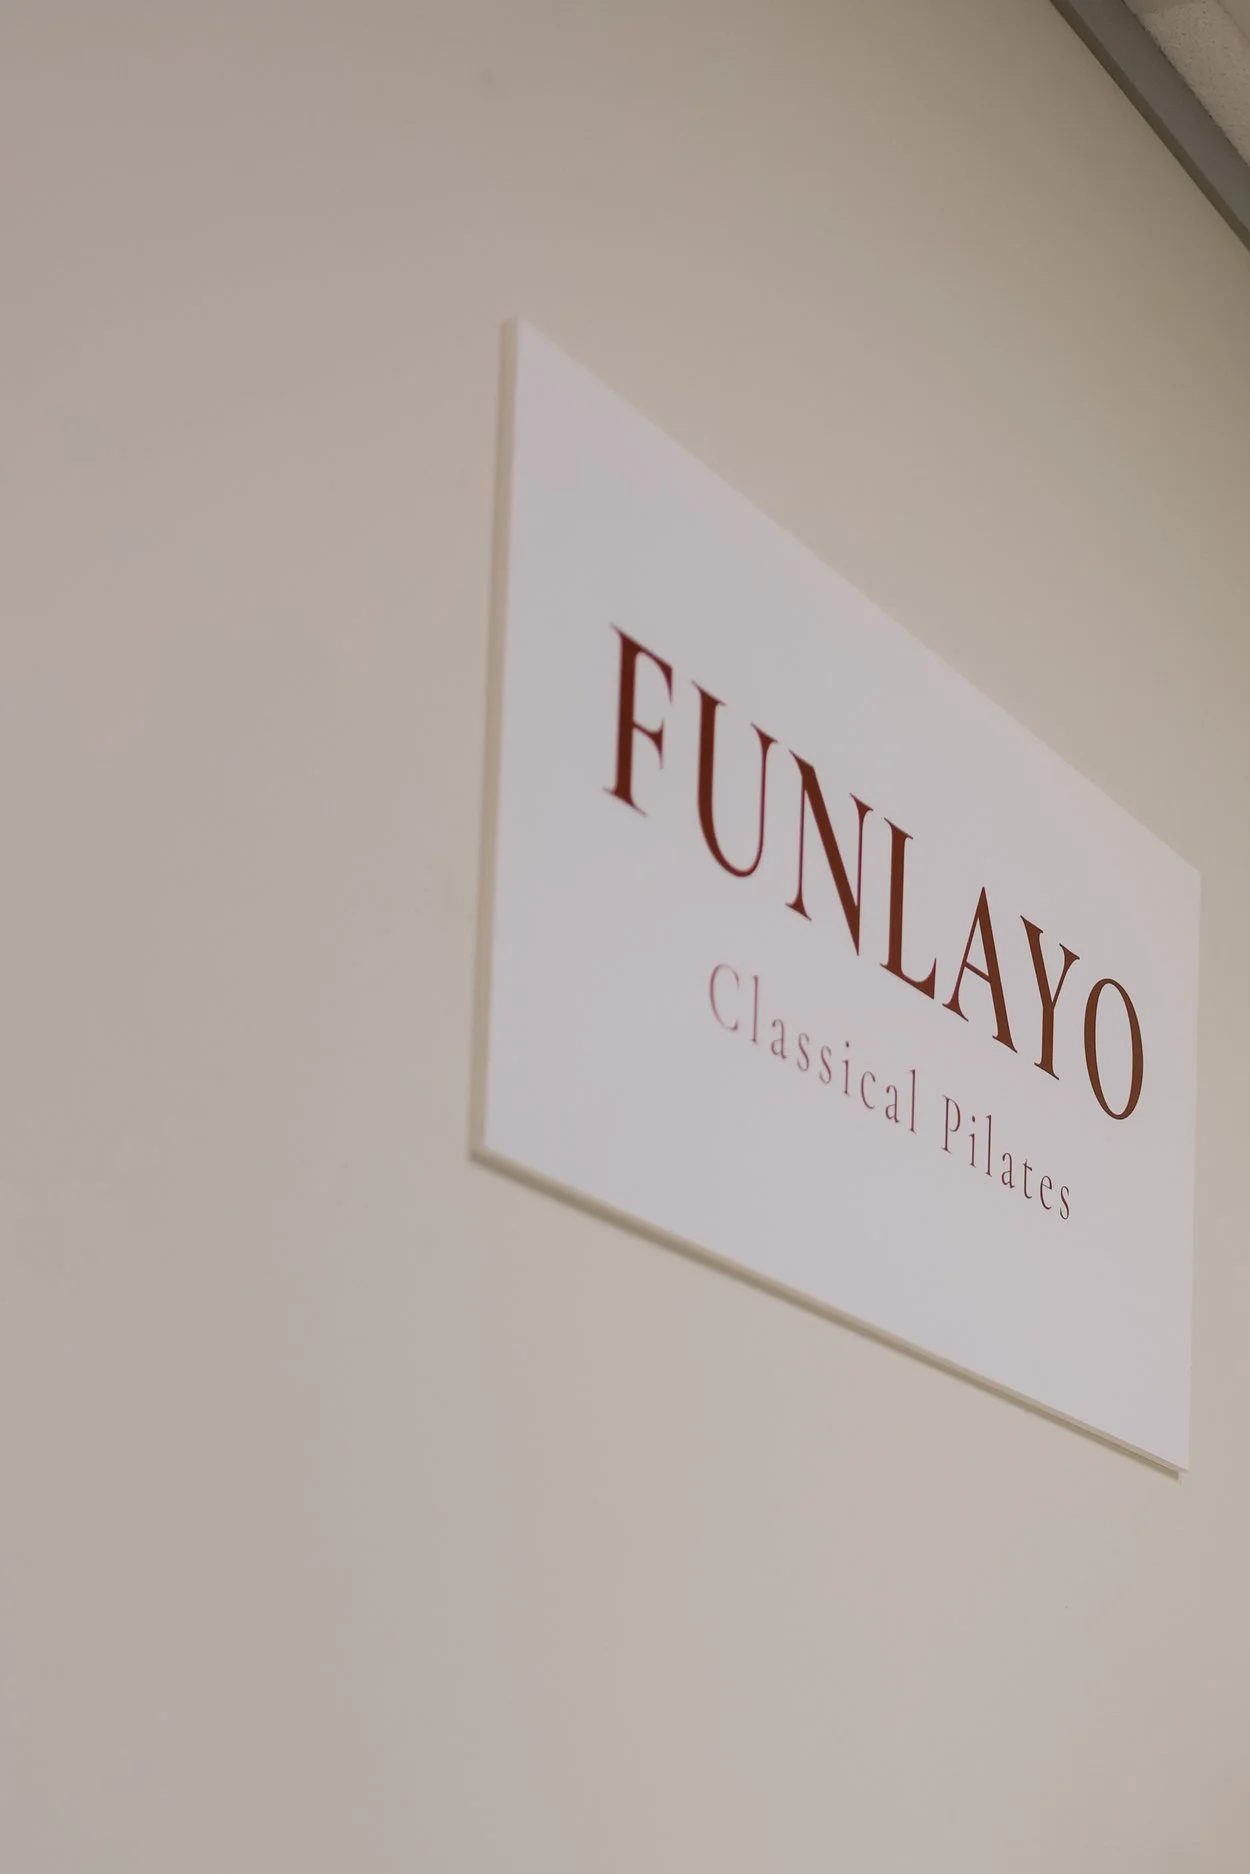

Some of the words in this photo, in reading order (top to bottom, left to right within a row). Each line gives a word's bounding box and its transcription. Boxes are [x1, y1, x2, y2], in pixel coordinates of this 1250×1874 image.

[602, 621, 1145, 1121] FUNLAYO
[708, 962, 918, 1135] Classical
[940, 1093, 1072, 1221] Pilates
